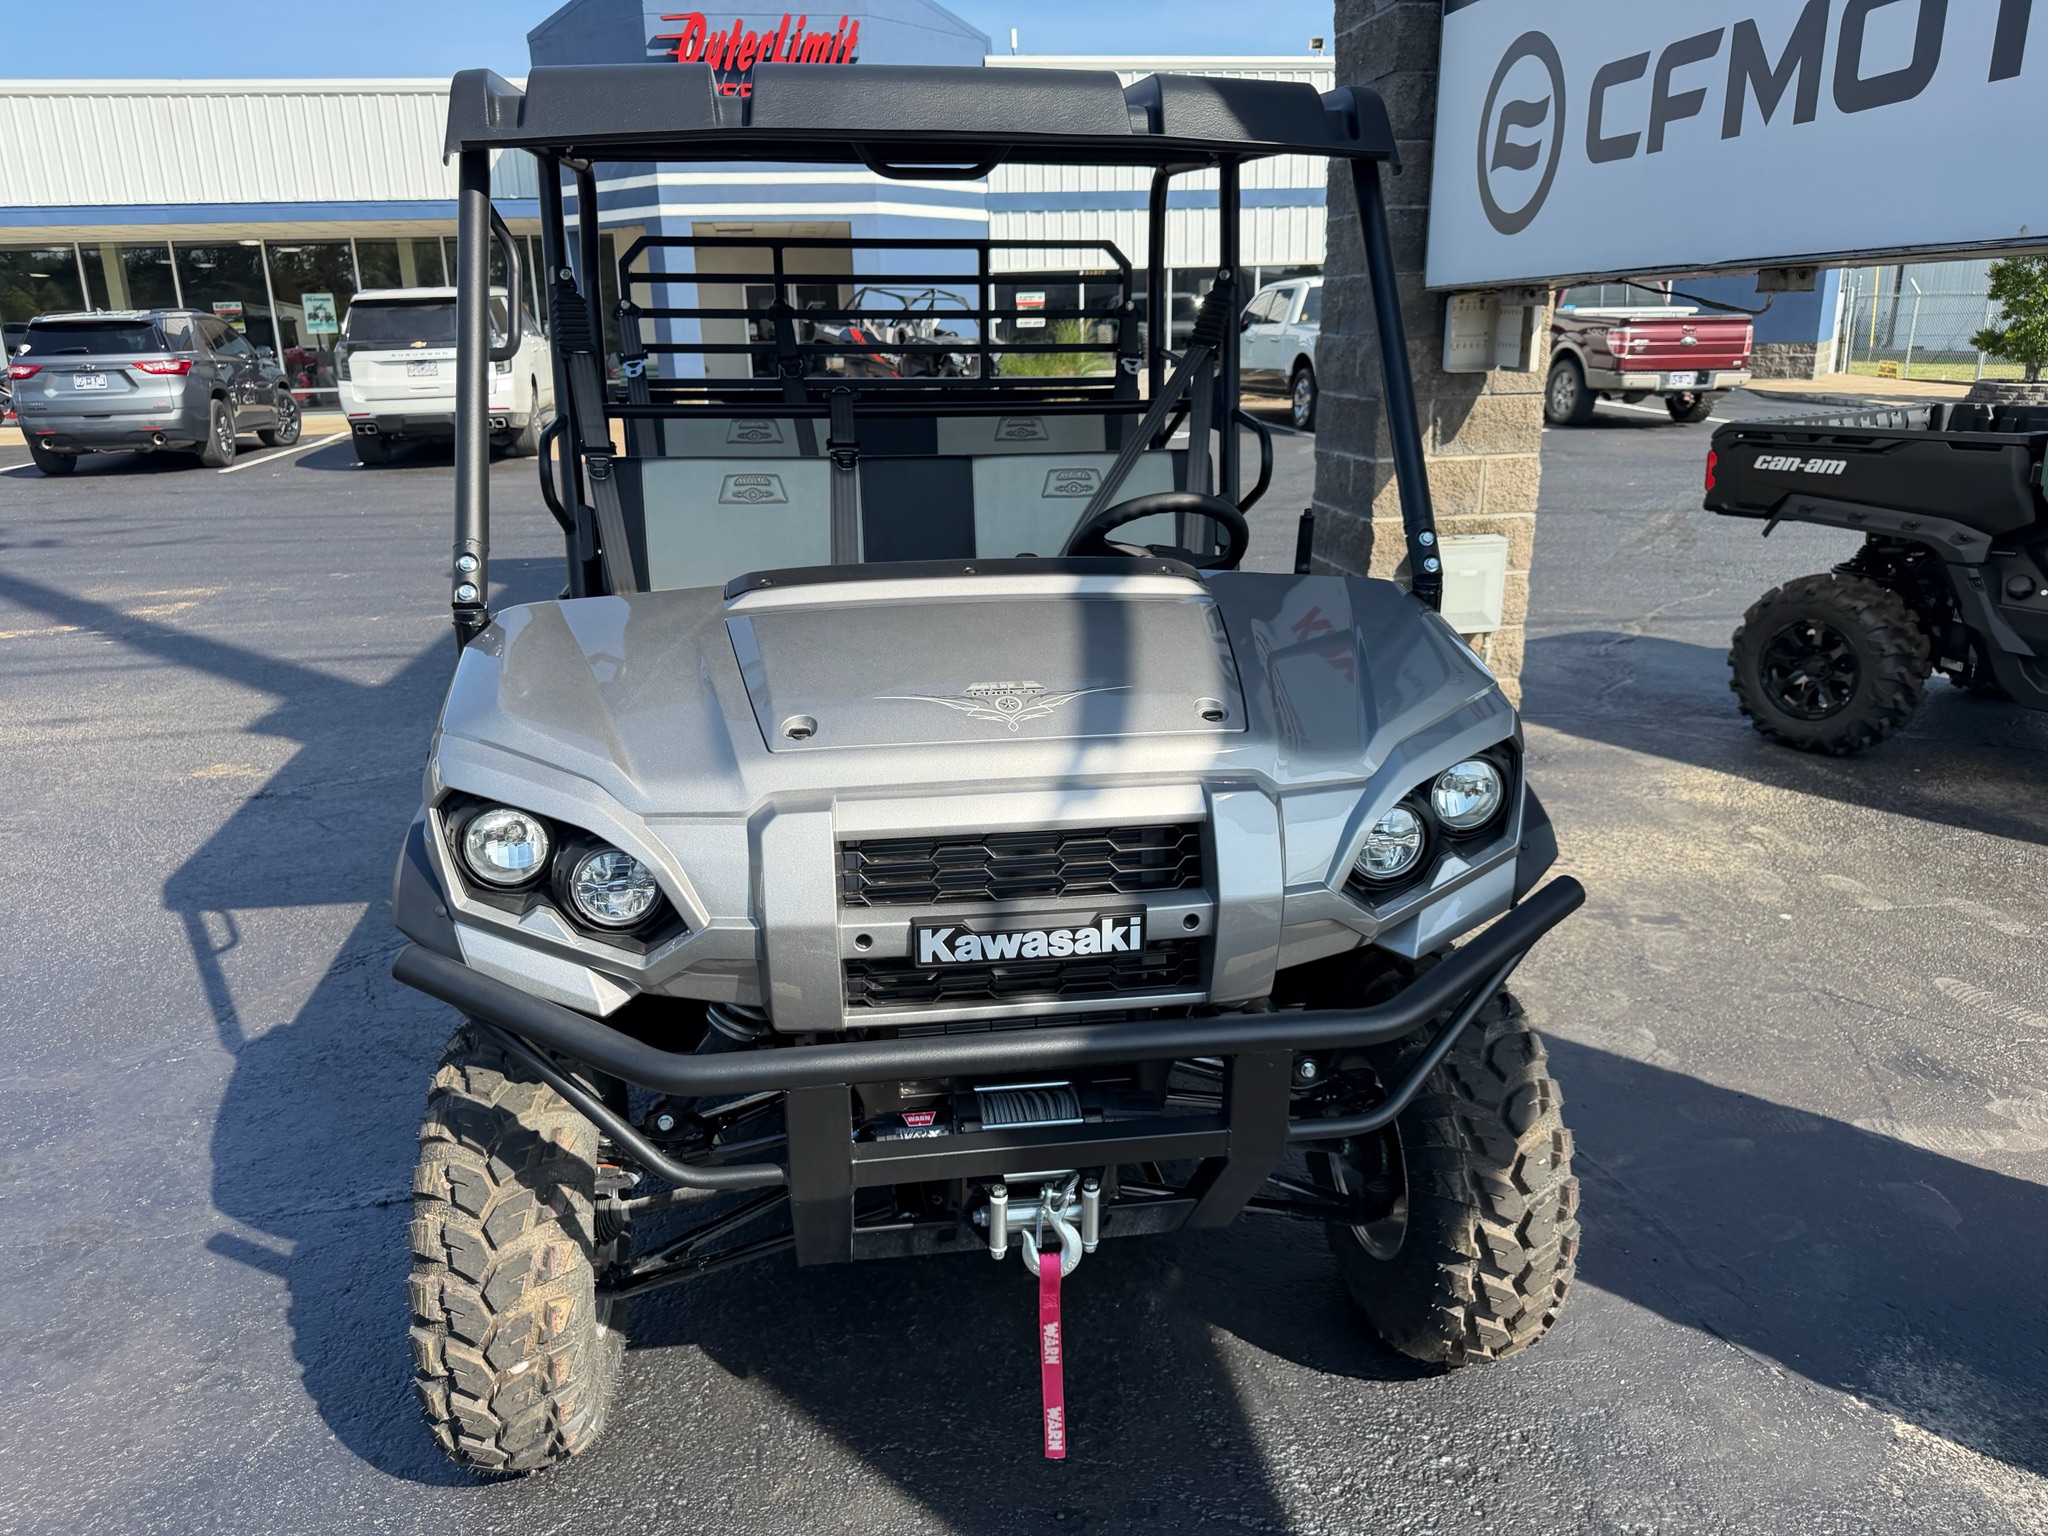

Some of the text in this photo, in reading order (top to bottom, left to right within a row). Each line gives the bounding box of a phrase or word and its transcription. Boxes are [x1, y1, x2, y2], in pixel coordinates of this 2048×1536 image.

[1753, 454, 1848, 475] can-am
[919, 916, 1142, 965] Kawasaki
[1043, 1321, 1060, 1365] WARN
[1046, 1405, 1063, 1451] WARN
